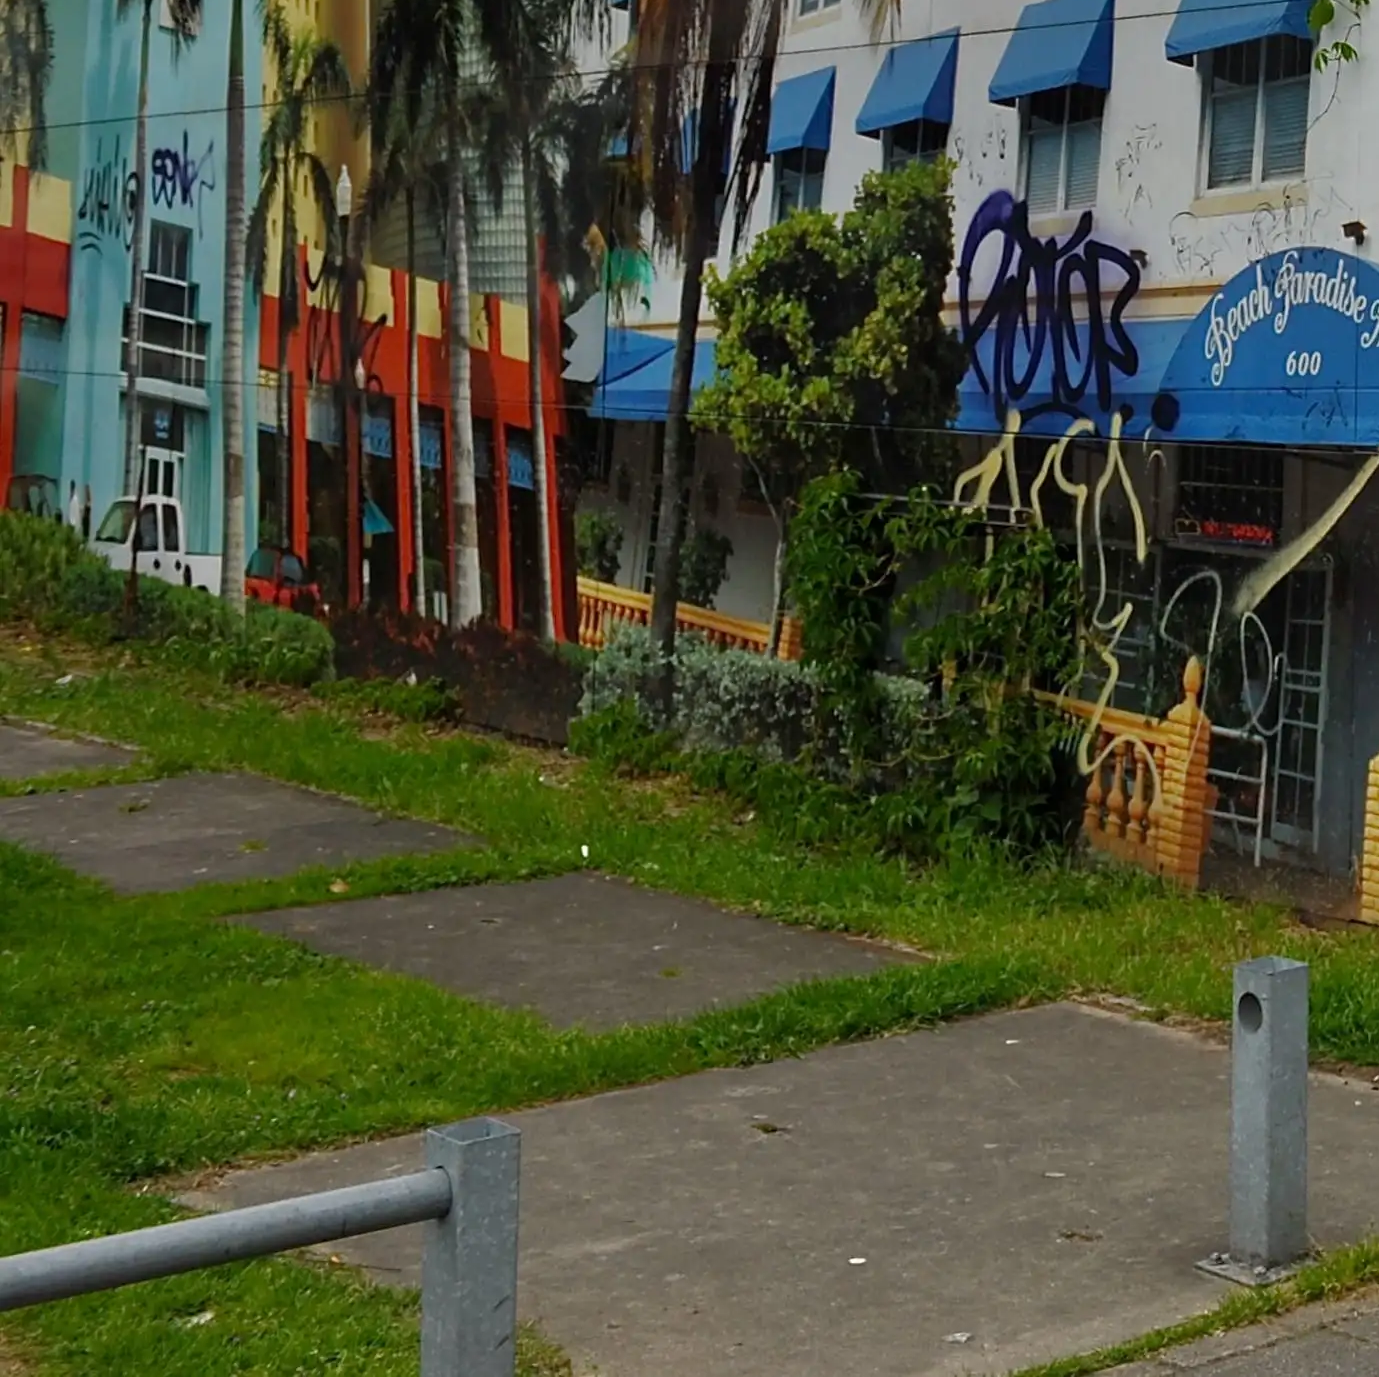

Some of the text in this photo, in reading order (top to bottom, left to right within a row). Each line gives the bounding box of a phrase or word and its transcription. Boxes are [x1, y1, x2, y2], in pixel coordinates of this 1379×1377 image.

[1204, 263, 1273, 387] Beach
[1273, 250, 1368, 334] Paradise
[1285, 350, 1322, 376] 600
